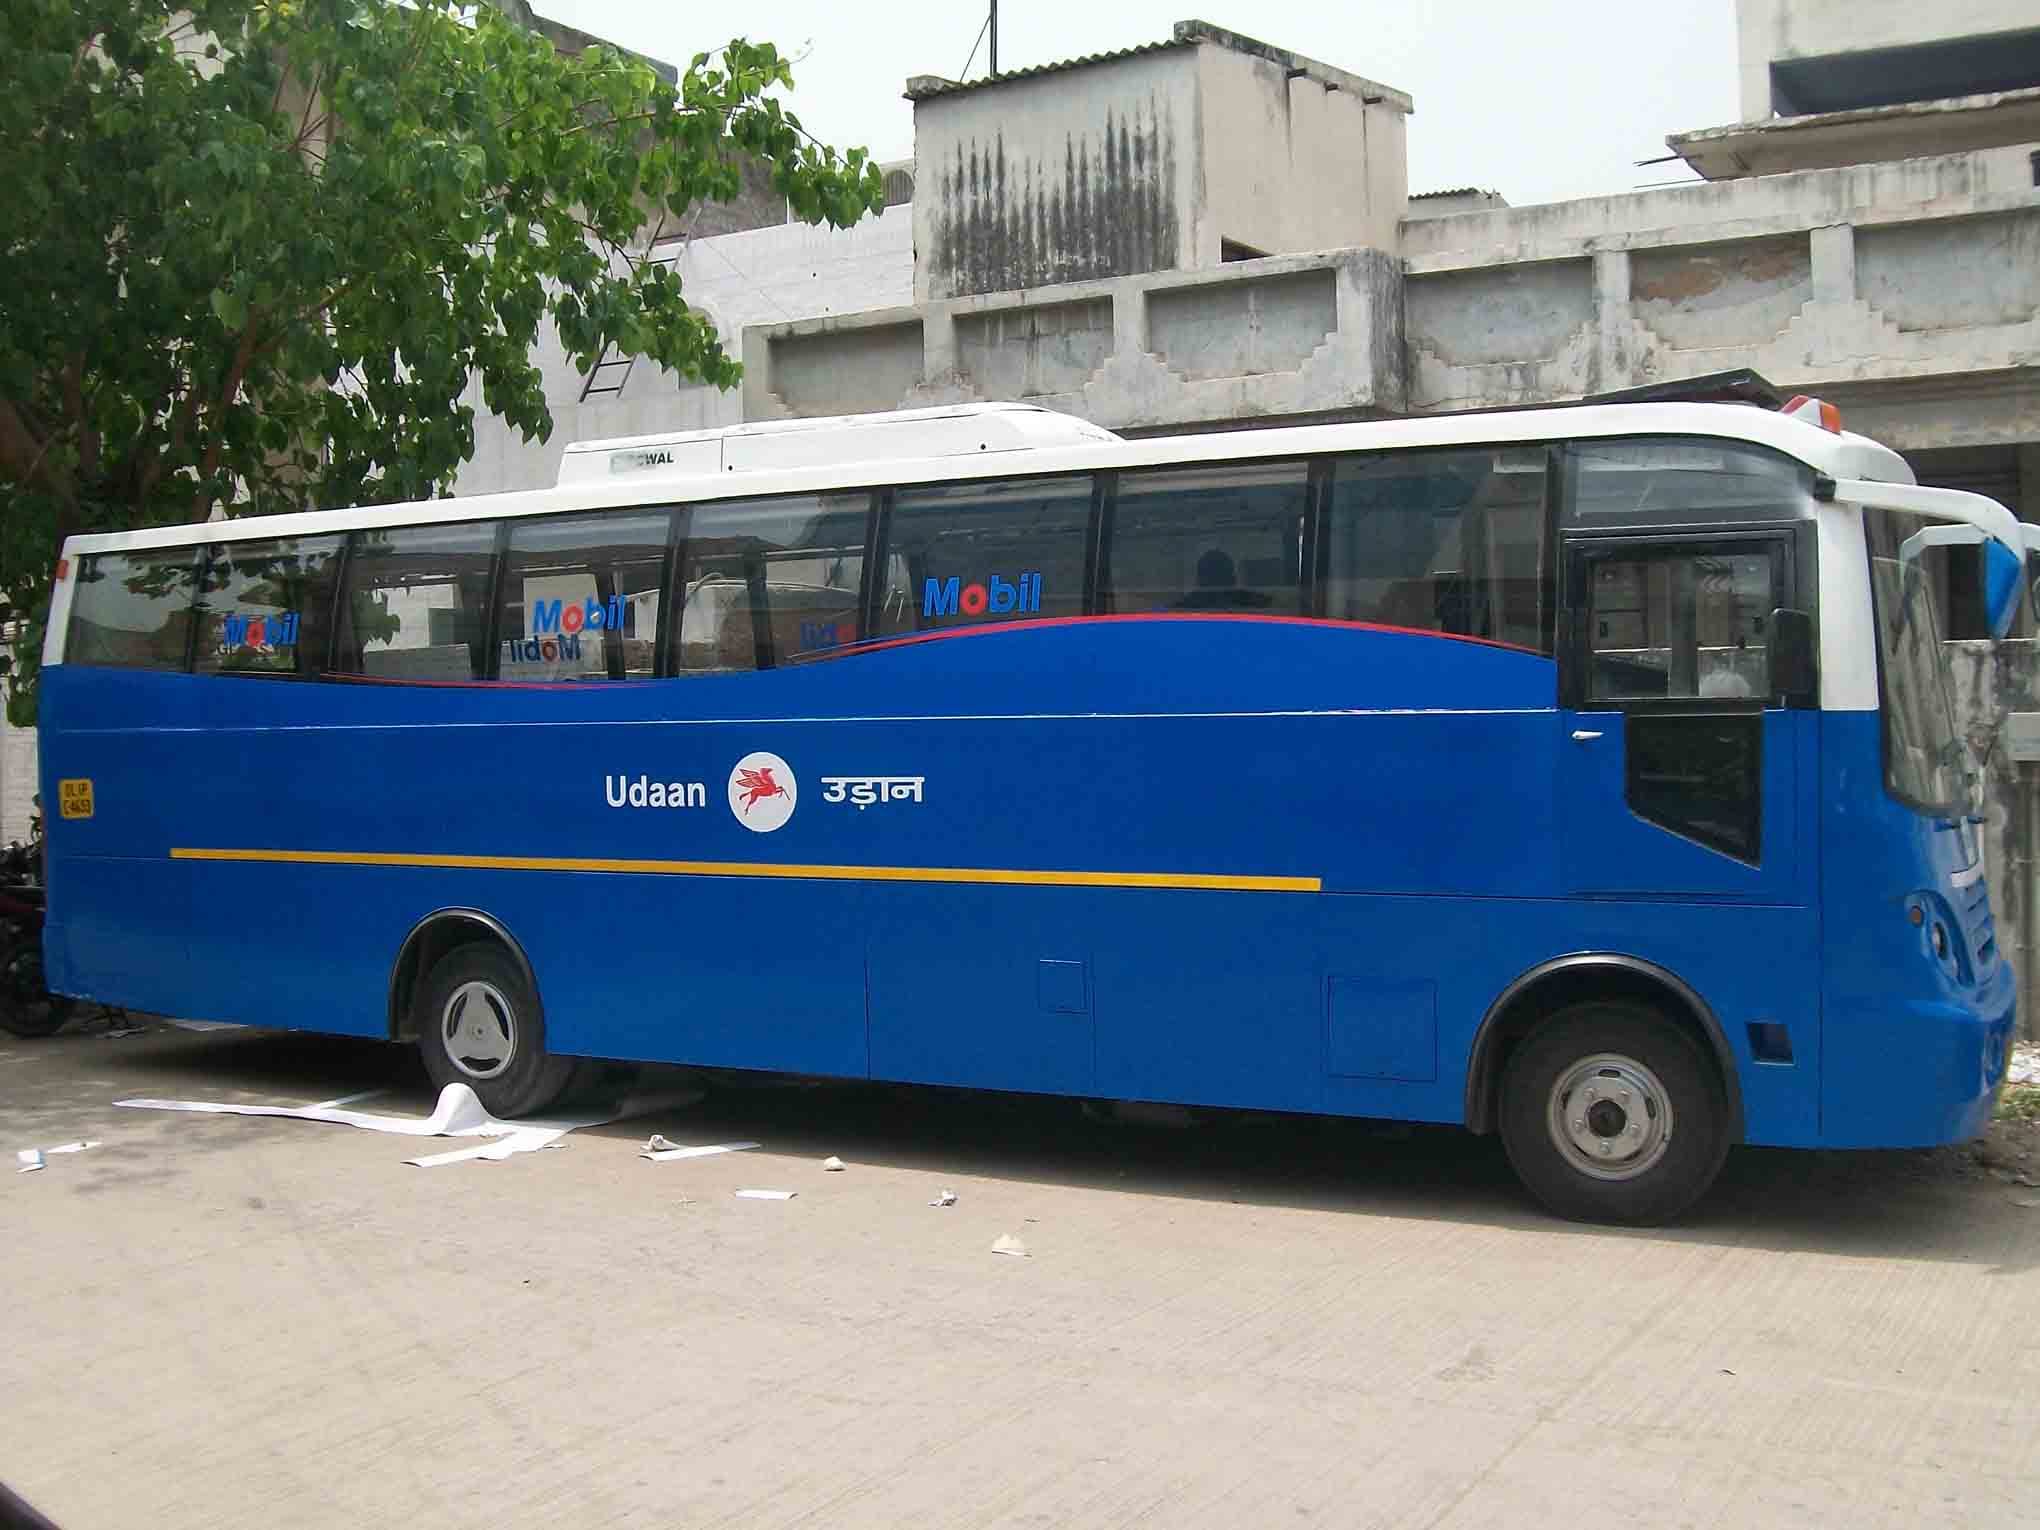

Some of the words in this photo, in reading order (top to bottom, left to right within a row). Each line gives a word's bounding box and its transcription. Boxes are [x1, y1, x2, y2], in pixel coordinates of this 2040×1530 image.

[923, 570, 1041, 616] Mobil
[223, 610, 301, 647] Mobil
[532, 592, 626, 634] Mobil
[605, 774, 707, 808] Udaan
[820, 776, 925, 810] उड़ान
